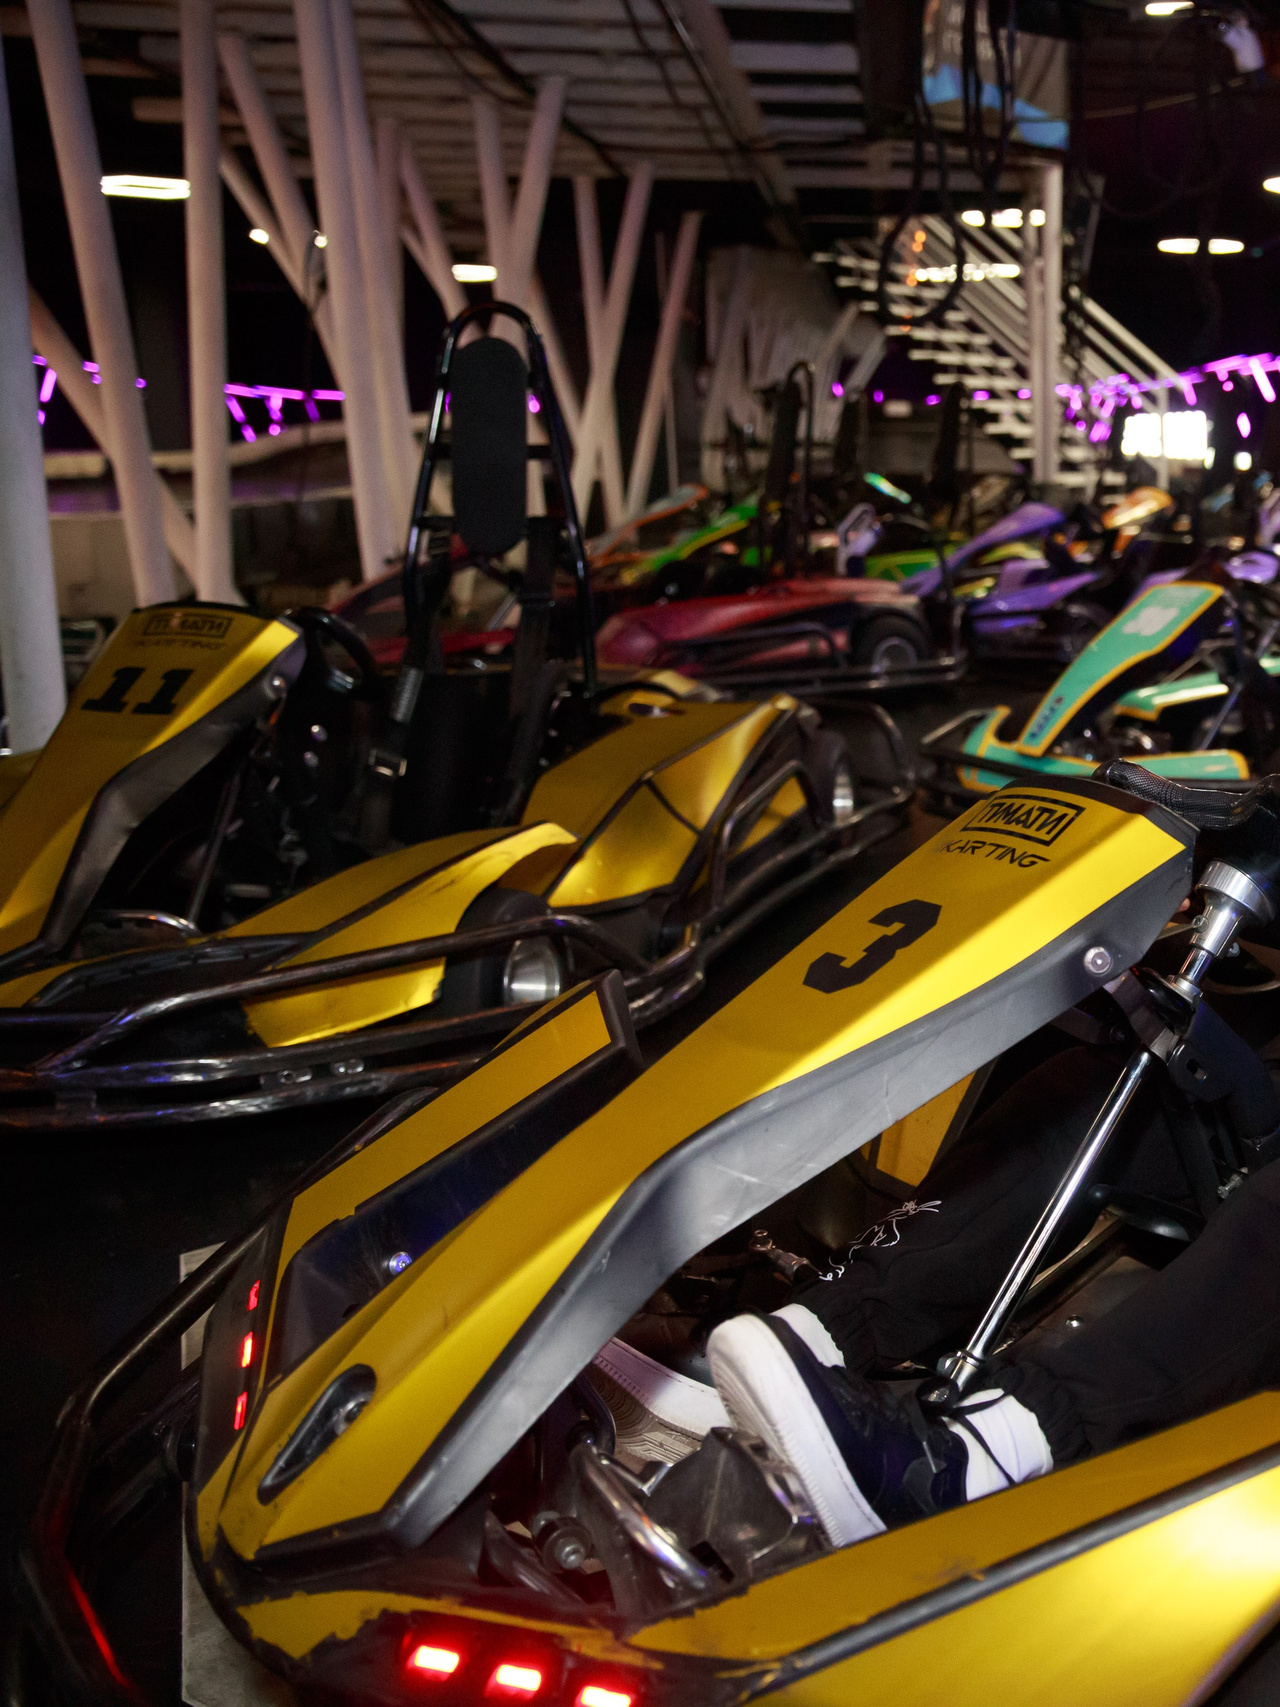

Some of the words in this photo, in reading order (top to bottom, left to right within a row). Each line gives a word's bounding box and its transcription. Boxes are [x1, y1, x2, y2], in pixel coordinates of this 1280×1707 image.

[81, 667, 195, 714] 11
[977, 802, 1070, 835] ТИМАТИ
[938, 839, 1051, 868] KARTING
[802, 898, 943, 994] 3
